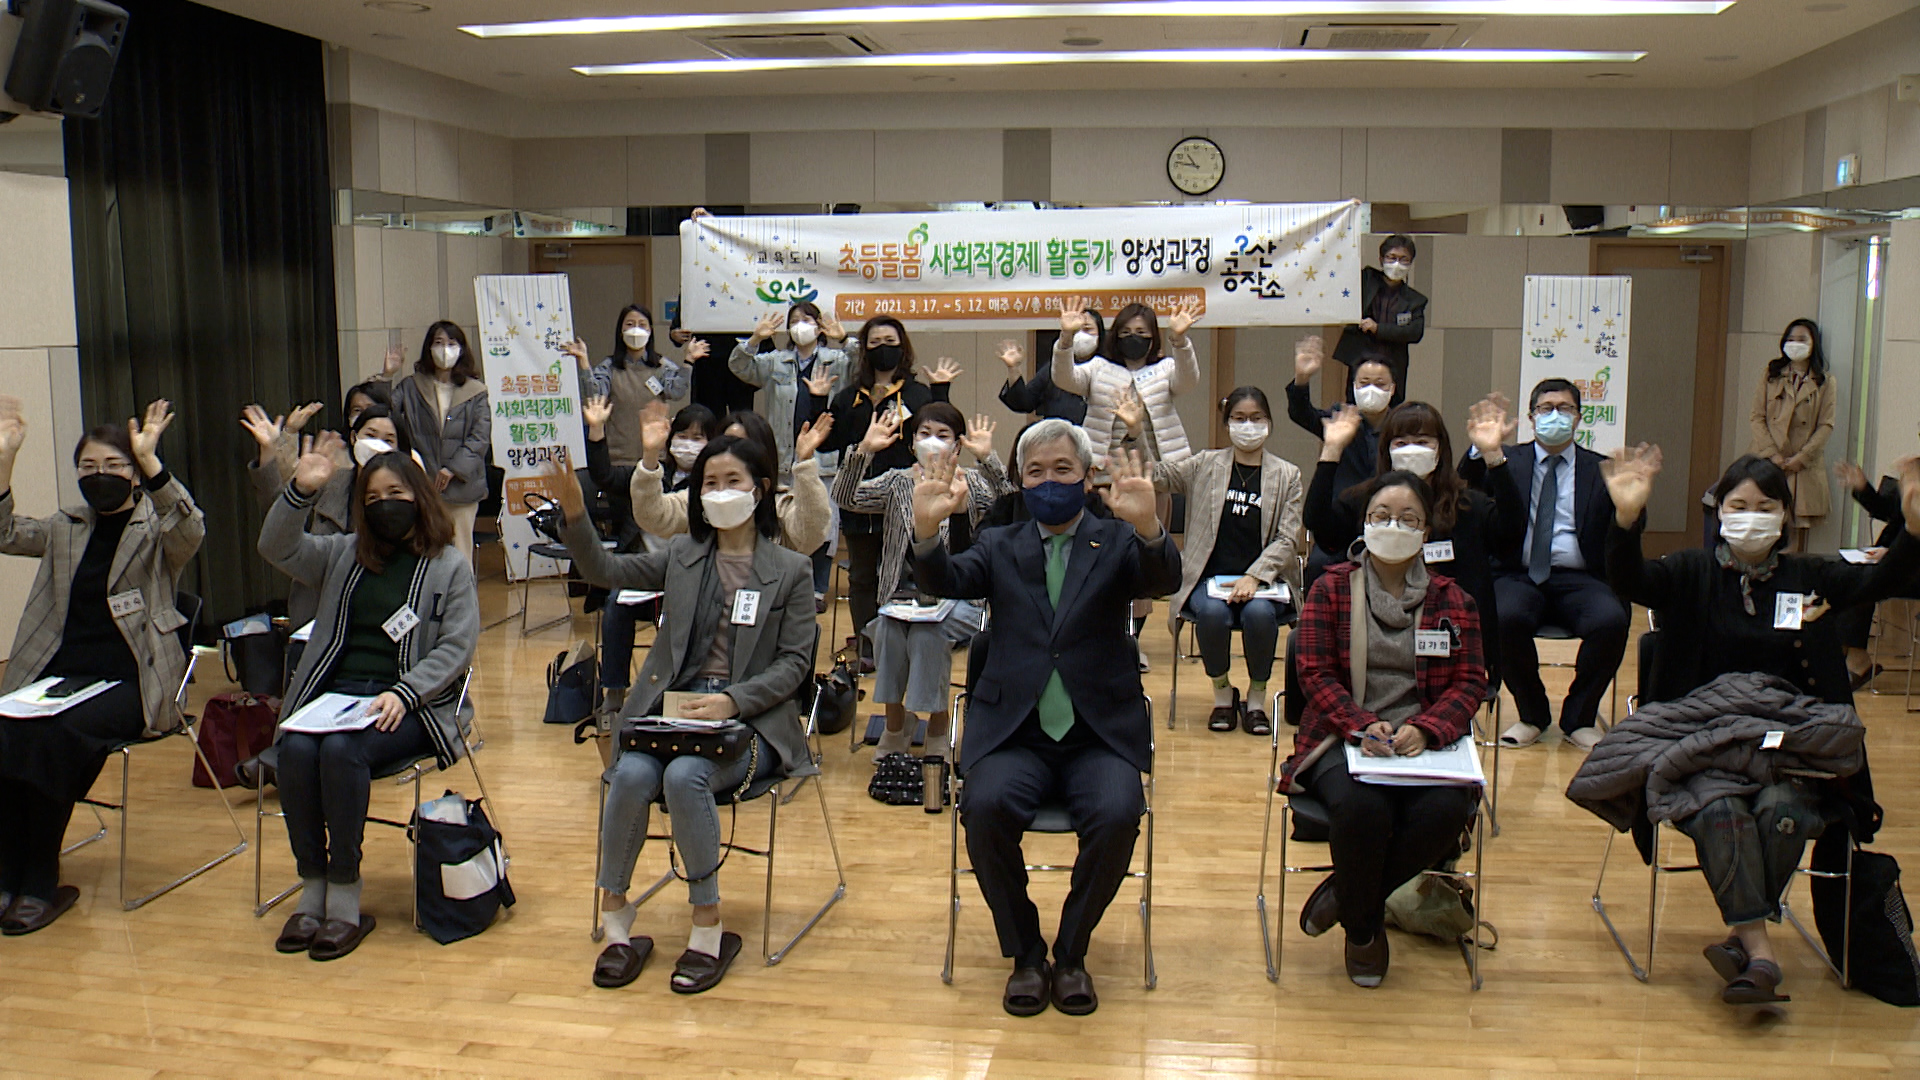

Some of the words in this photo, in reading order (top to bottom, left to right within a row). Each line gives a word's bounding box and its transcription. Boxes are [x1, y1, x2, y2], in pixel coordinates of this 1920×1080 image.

[756, 251, 818, 266] 교육도시
[837, 242, 923, 281] 초등돌봄
[929, 239, 1040, 279] 사회적경제
[1046, 236, 1114, 277] 활동가
[1121, 236, 1212, 276] 양성과정
[844, 300, 866, 317] 기간
[874, 299, 906, 315] 2021.
[923, 298, 940, 314] 17.
[954, 298, 966, 313] 5.
[968, 298, 986, 313] 12.
[988, 297, 1010, 313] 매주
[500, 374, 560, 395] 초등돌봄
[495, 397, 572, 418] 사회적경제
[509, 422, 557, 443] 활동가
[1232, 503, 1250, 516] NY
